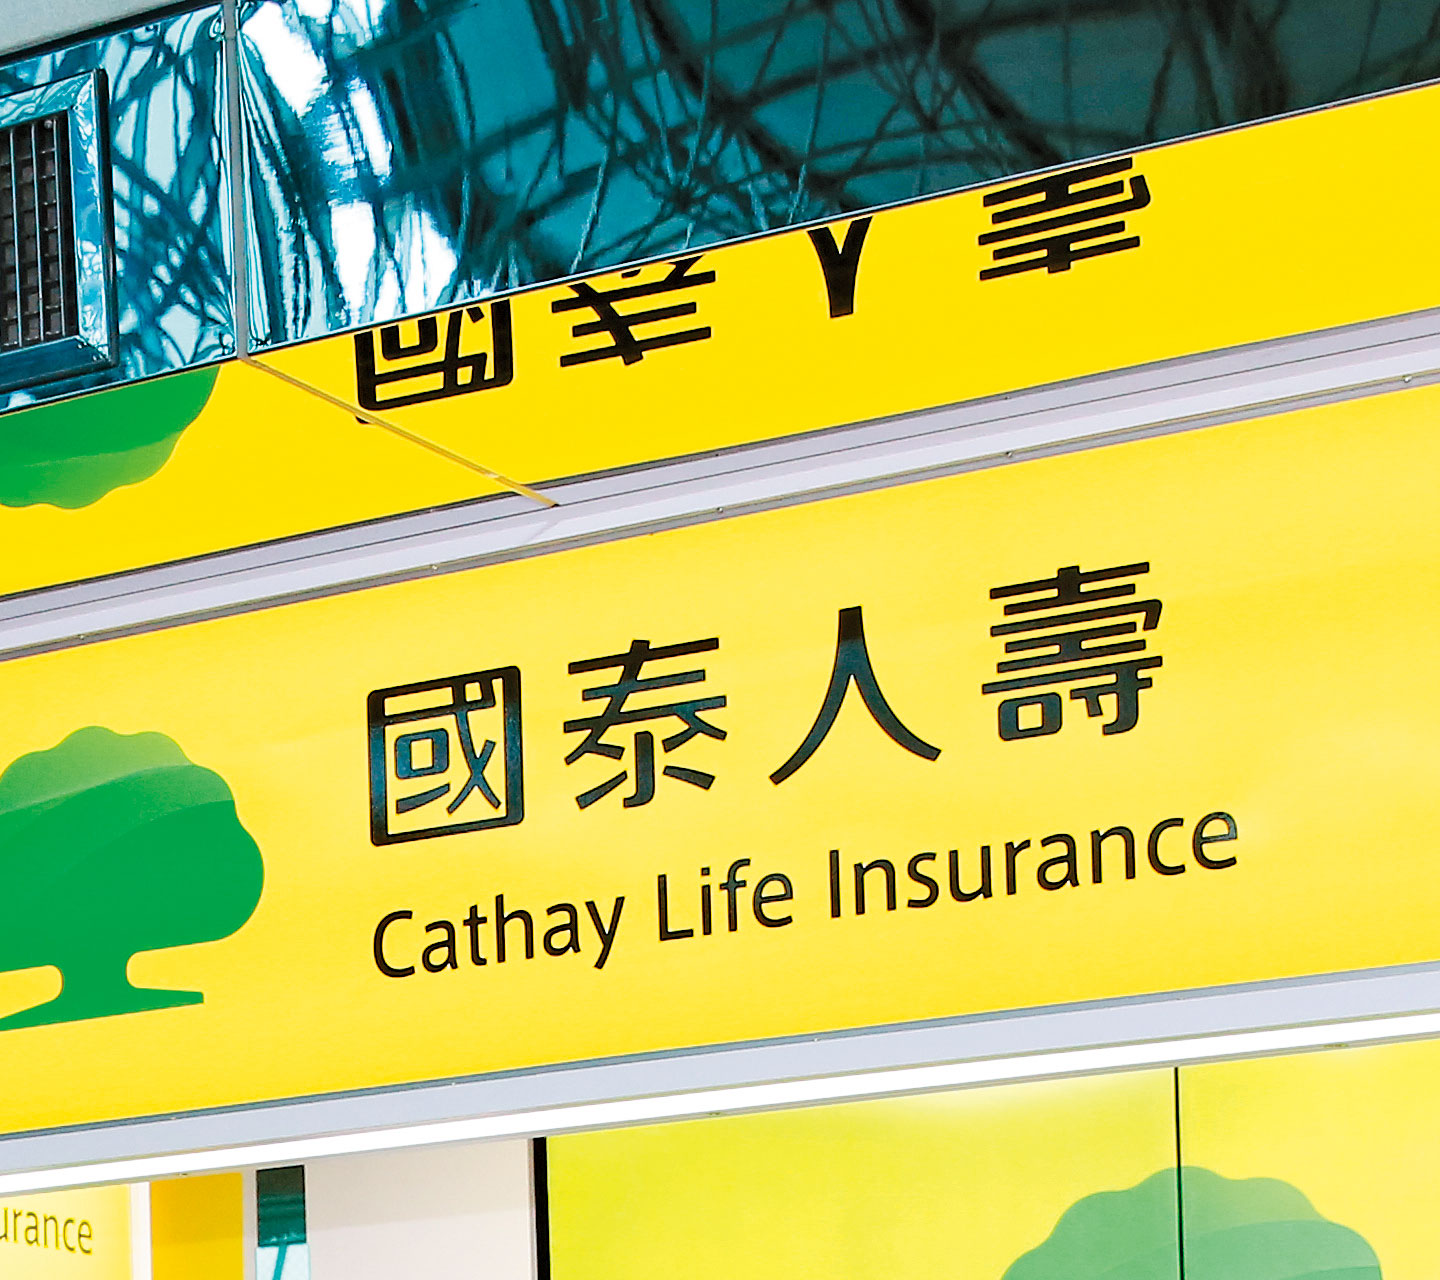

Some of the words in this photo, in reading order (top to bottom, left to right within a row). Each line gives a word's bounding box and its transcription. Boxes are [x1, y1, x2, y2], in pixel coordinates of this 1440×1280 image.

[368, 560, 1164, 847] 國泰人壽
[373, 892, 625, 979] Cathay
[657, 858, 794, 942] Life
[829, 811, 1238, 920] Insurance
